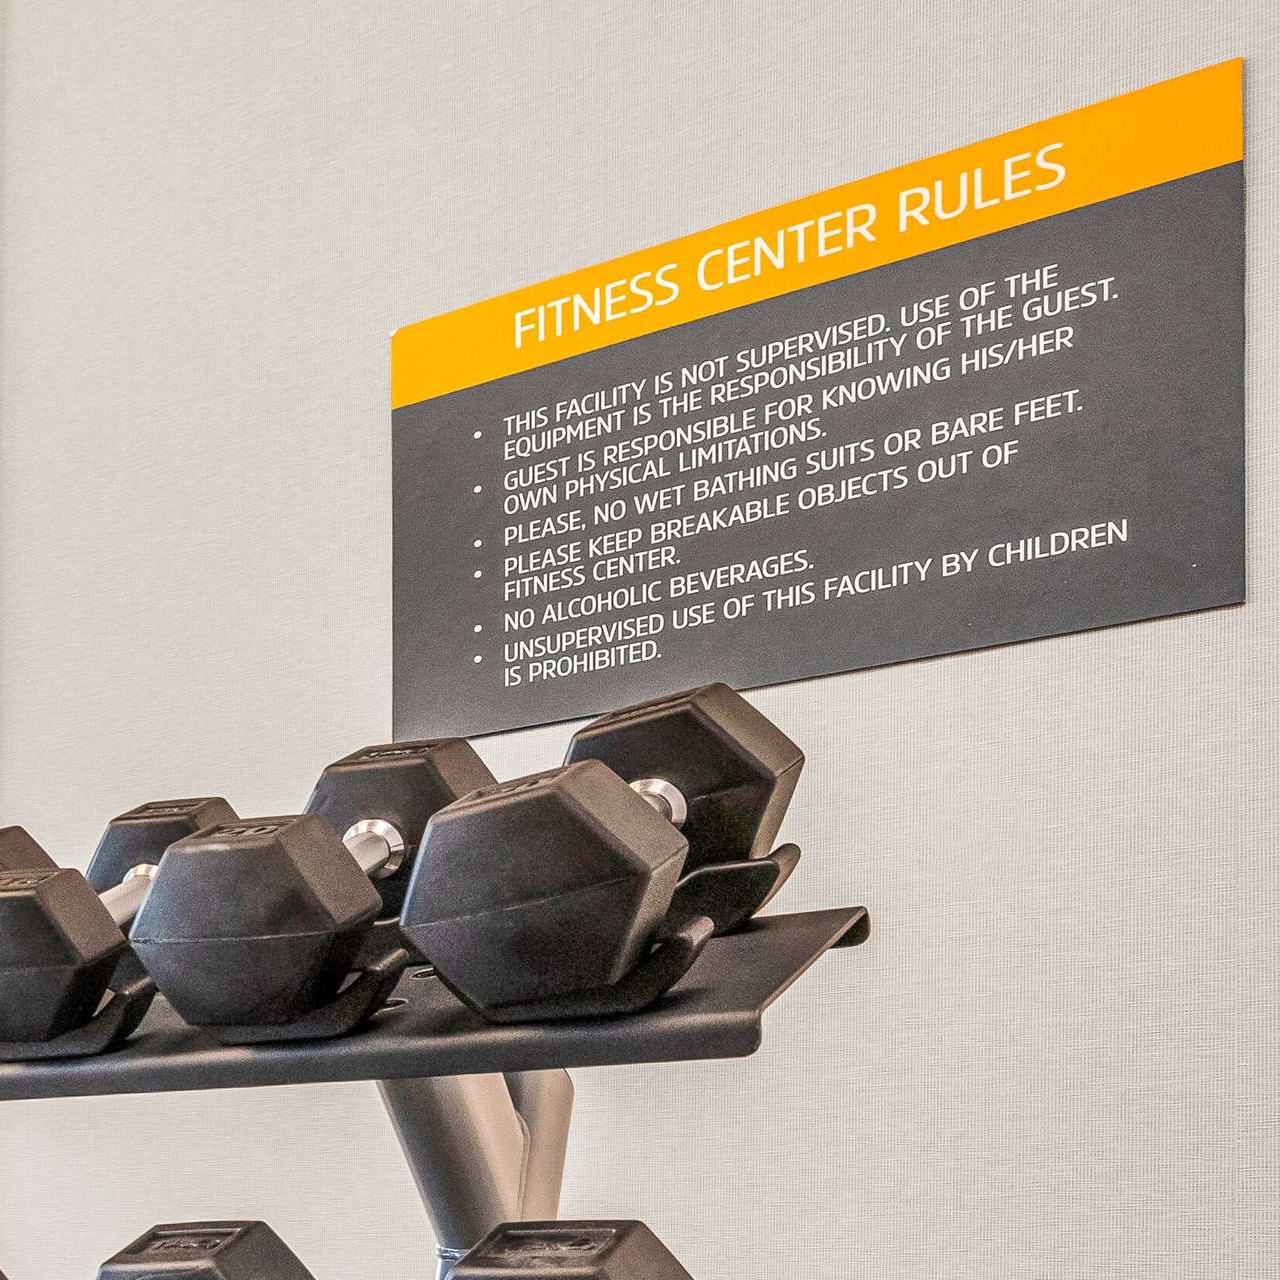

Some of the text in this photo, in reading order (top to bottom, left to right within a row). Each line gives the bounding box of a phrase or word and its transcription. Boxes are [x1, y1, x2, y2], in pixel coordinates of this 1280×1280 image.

[515, 143, 1065, 348] FITNESS CENTER RULES
[503, 264, 1058, 436] THIS FACILITY IS NOT SUPERVISED. USE OF THE
[504, 277, 1118, 461] EQUIPMENT IS THE RESPONSIBILITY OF THE GUEST.
[504, 326, 1073, 490] GUEST IS RESPONSIBLE FOR KNOWING HIS/HER
[504, 417, 827, 515] OWN PHYSICAL LIMITATIONS.
[505, 389, 1083, 546] PLEASE, NO WET BATHING SUITS OR BARE FEET.
[505, 440, 1019, 577] PLEASE KEEP BREAKABLE OBJECTS OUT OF
[504, 546, 681, 601] FITNESS CENTER.
[504, 519, 1127, 663] UNSUPERVISED USE OF THIS FACILITY BY CHILDREN
[505, 549, 814, 632] NO ALCOHOLIC BEVERAGES.
[505, 640, 662, 687] IS PROHIBITED.
